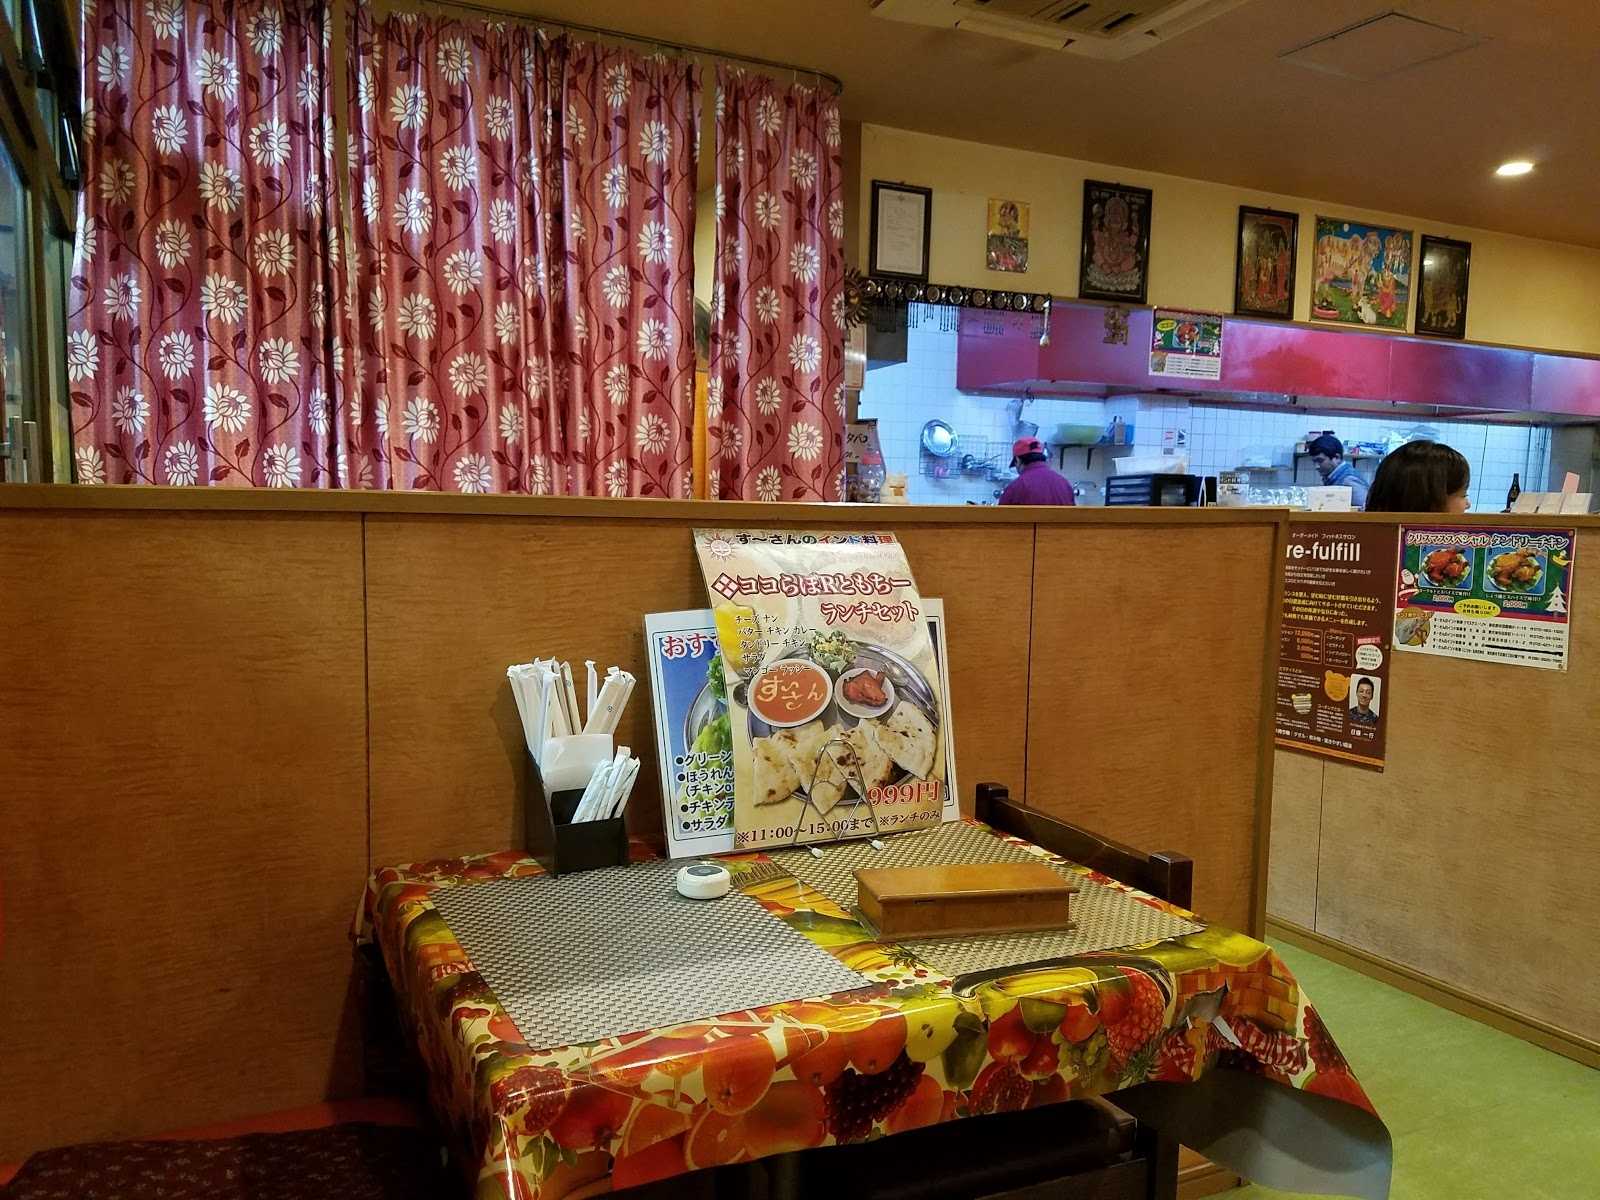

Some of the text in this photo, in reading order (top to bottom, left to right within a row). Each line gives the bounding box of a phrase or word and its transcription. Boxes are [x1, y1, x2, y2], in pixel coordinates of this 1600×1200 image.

[1407, 531, 1568, 550] クリスマススペシャル タンドリーチキン
[1286, 541, 1361, 562] re-fulfill
[735, 614, 778, 624] チーズ ナン
[820, 601, 919, 626] ランチセット
[738, 624, 817, 637] バター チキン カレー
[782, 638, 806, 648] チキン
[742, 651, 766, 663] サラダ
[744, 665, 778, 677] マンゴー
[866, 780, 940, 806] 999円
